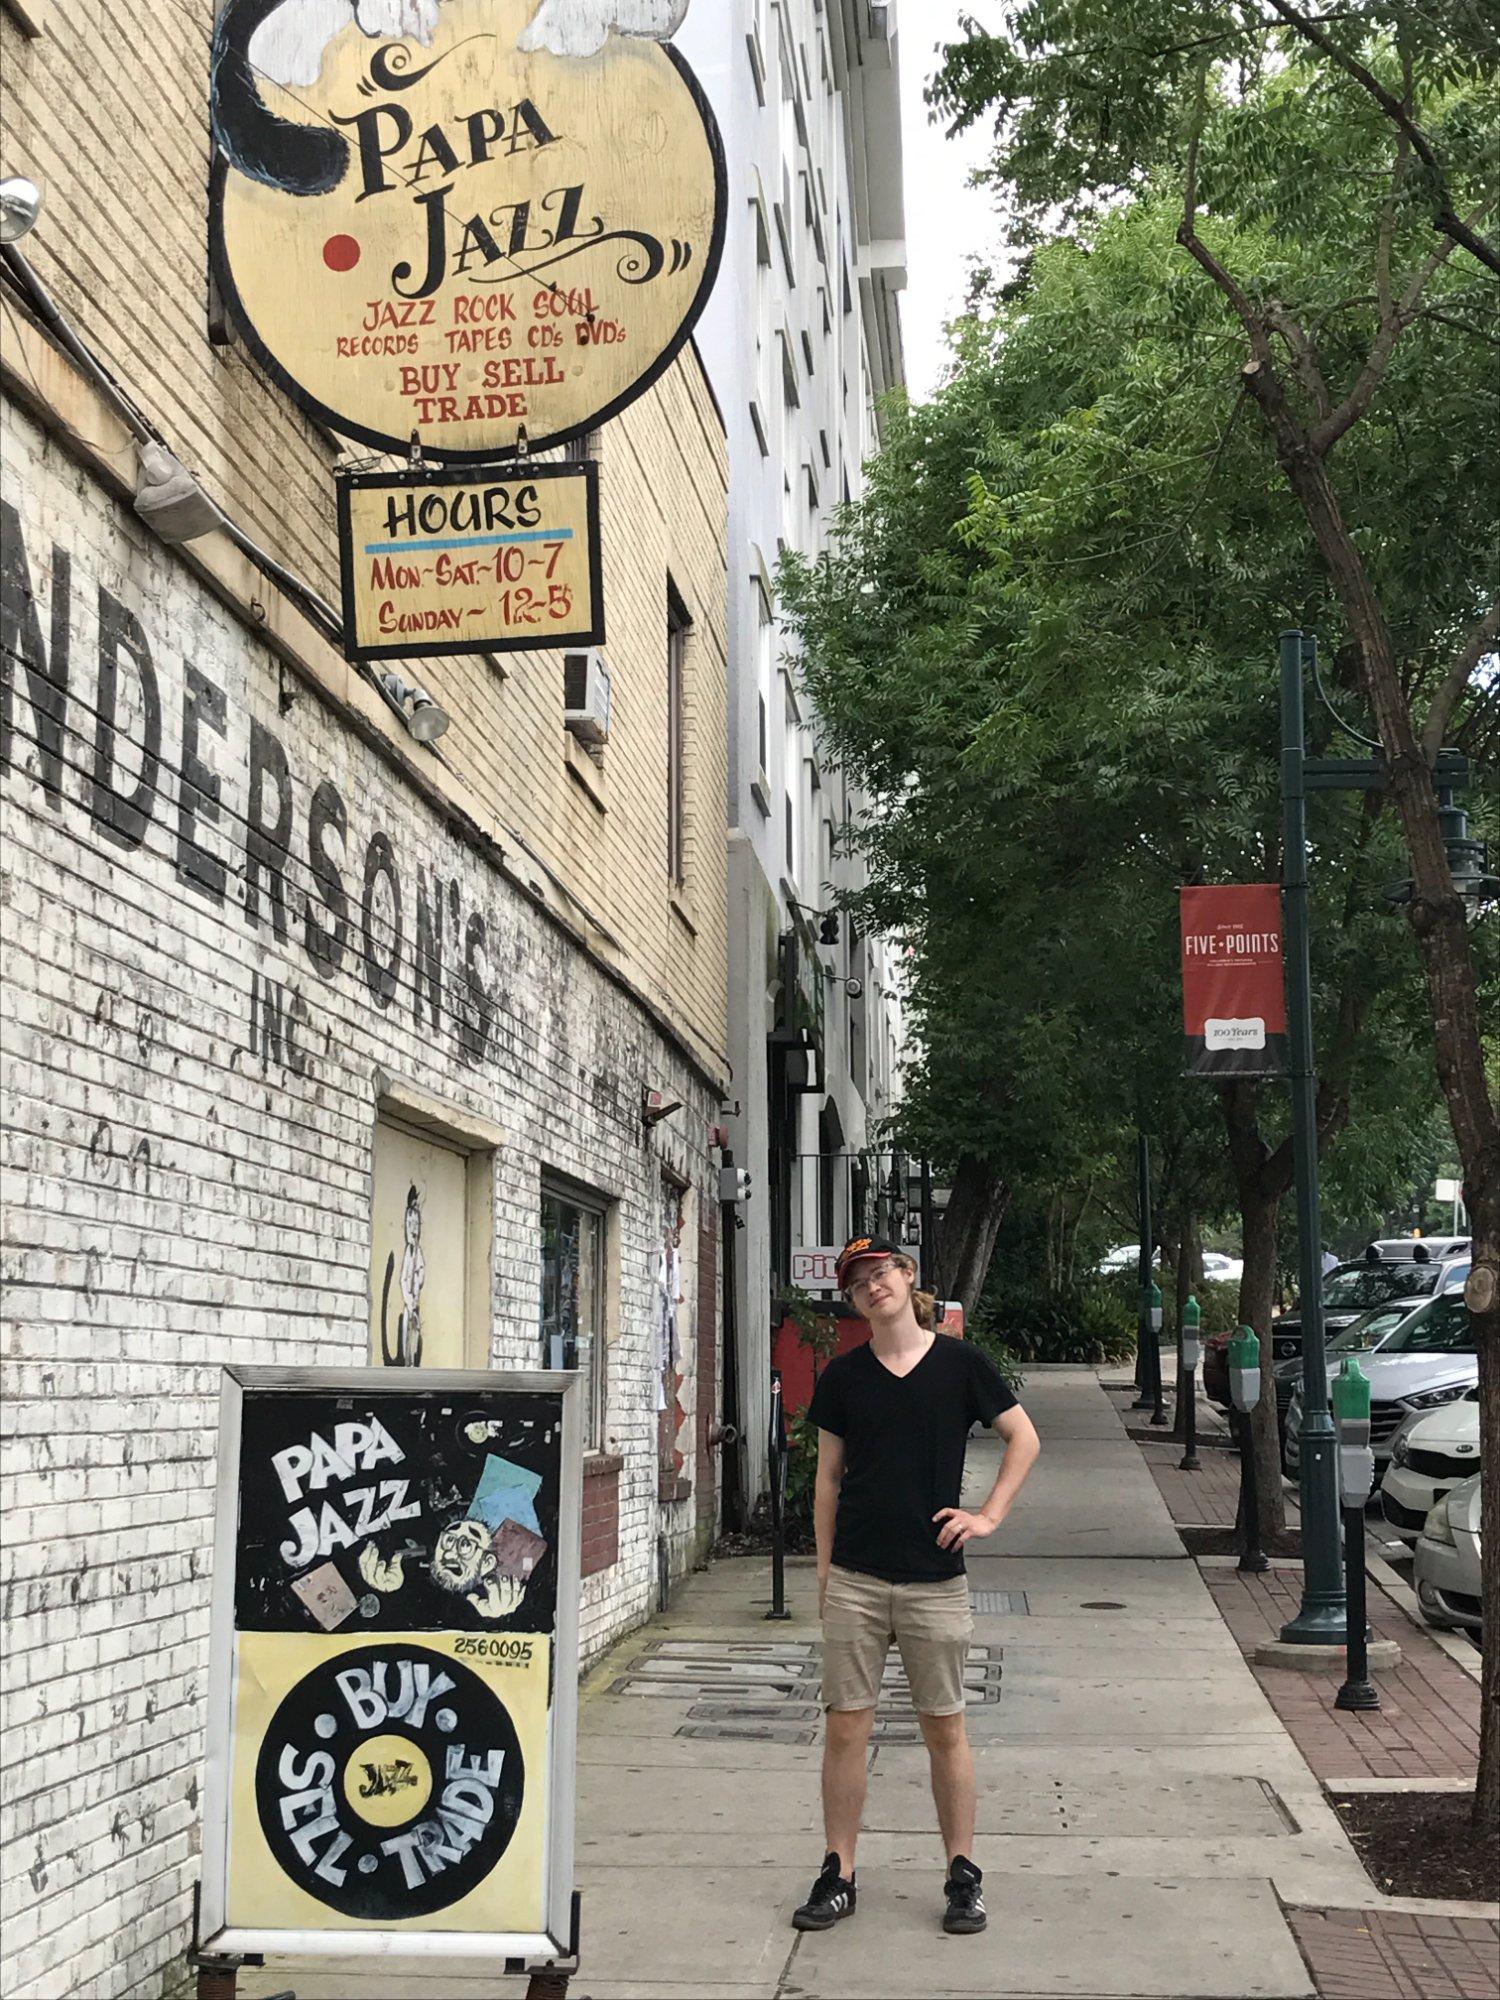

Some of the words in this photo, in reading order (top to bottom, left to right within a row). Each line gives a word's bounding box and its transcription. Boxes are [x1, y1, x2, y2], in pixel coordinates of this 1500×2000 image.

[328, 98, 563, 203] PAPA
[391, 183, 604, 299] JAZZ
[363, 300, 436, 331] JAZZ
[454, 293, 516, 325] ROCK
[533, 287, 599, 318] SOUL
[336, 332, 419, 358] RECORDS
[444, 326, 512, 353] TAPES
[527, 322, 563, 347] CD's
[400, 362, 461, 396] BUY
[482, 356, 565, 388] SELL
[413, 393, 528, 424] TRADE
[383, 485, 542, 538] HOURS
[1185, 935, 1217, 955] FIVE
[1226, 933, 1279, 954] POINTS
[1213, 1028, 1230, 1036] 100
[1231, 1027, 1258, 1036] Years
[271, 1416, 406, 1503] PAPA
[279, 1479, 422, 1568] JAZZ
[454, 1637, 533, 1660] 2560095
[335, 1660, 456, 1729] BUY
[278, 1743, 354, 1887] SELL
[380, 1743, 505, 1890] TRADE
